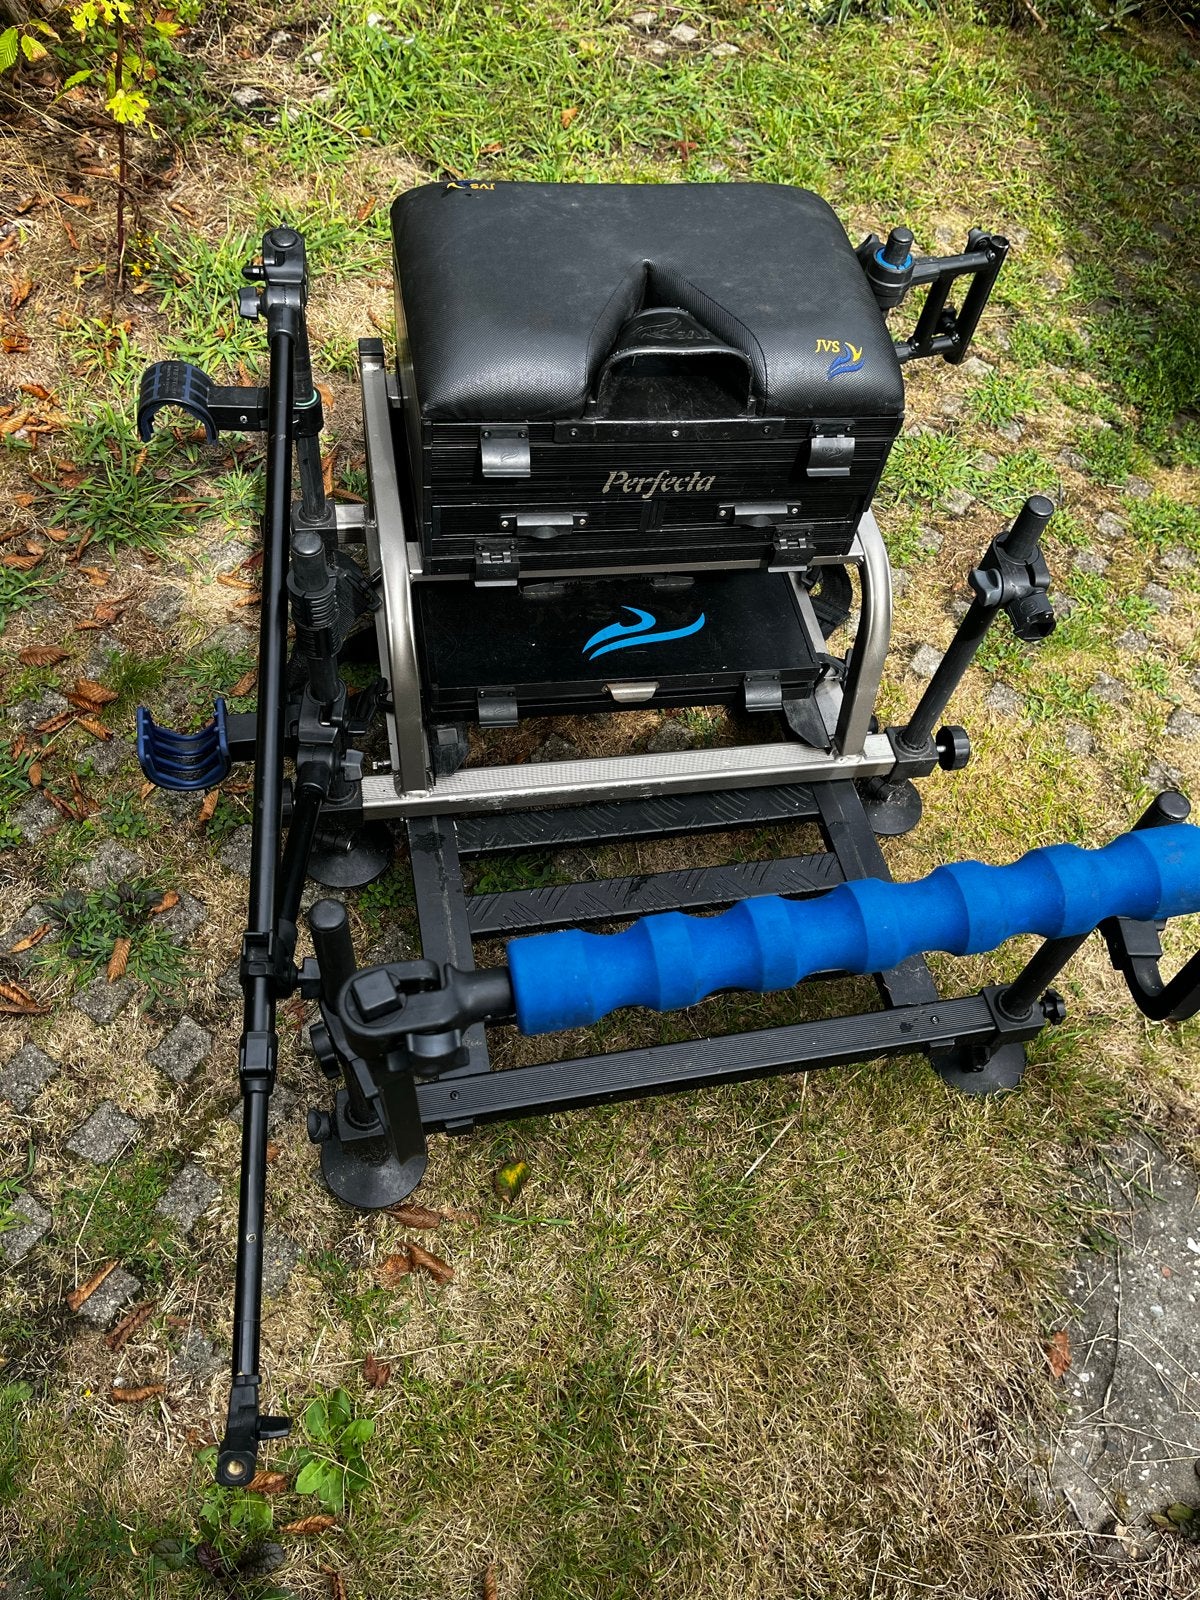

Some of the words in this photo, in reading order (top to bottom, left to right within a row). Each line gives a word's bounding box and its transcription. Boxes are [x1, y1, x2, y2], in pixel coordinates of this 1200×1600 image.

[470, 183, 495, 191] JVS
[815, 339, 840, 353] JVS
[602, 470, 716, 499] Perfecta
